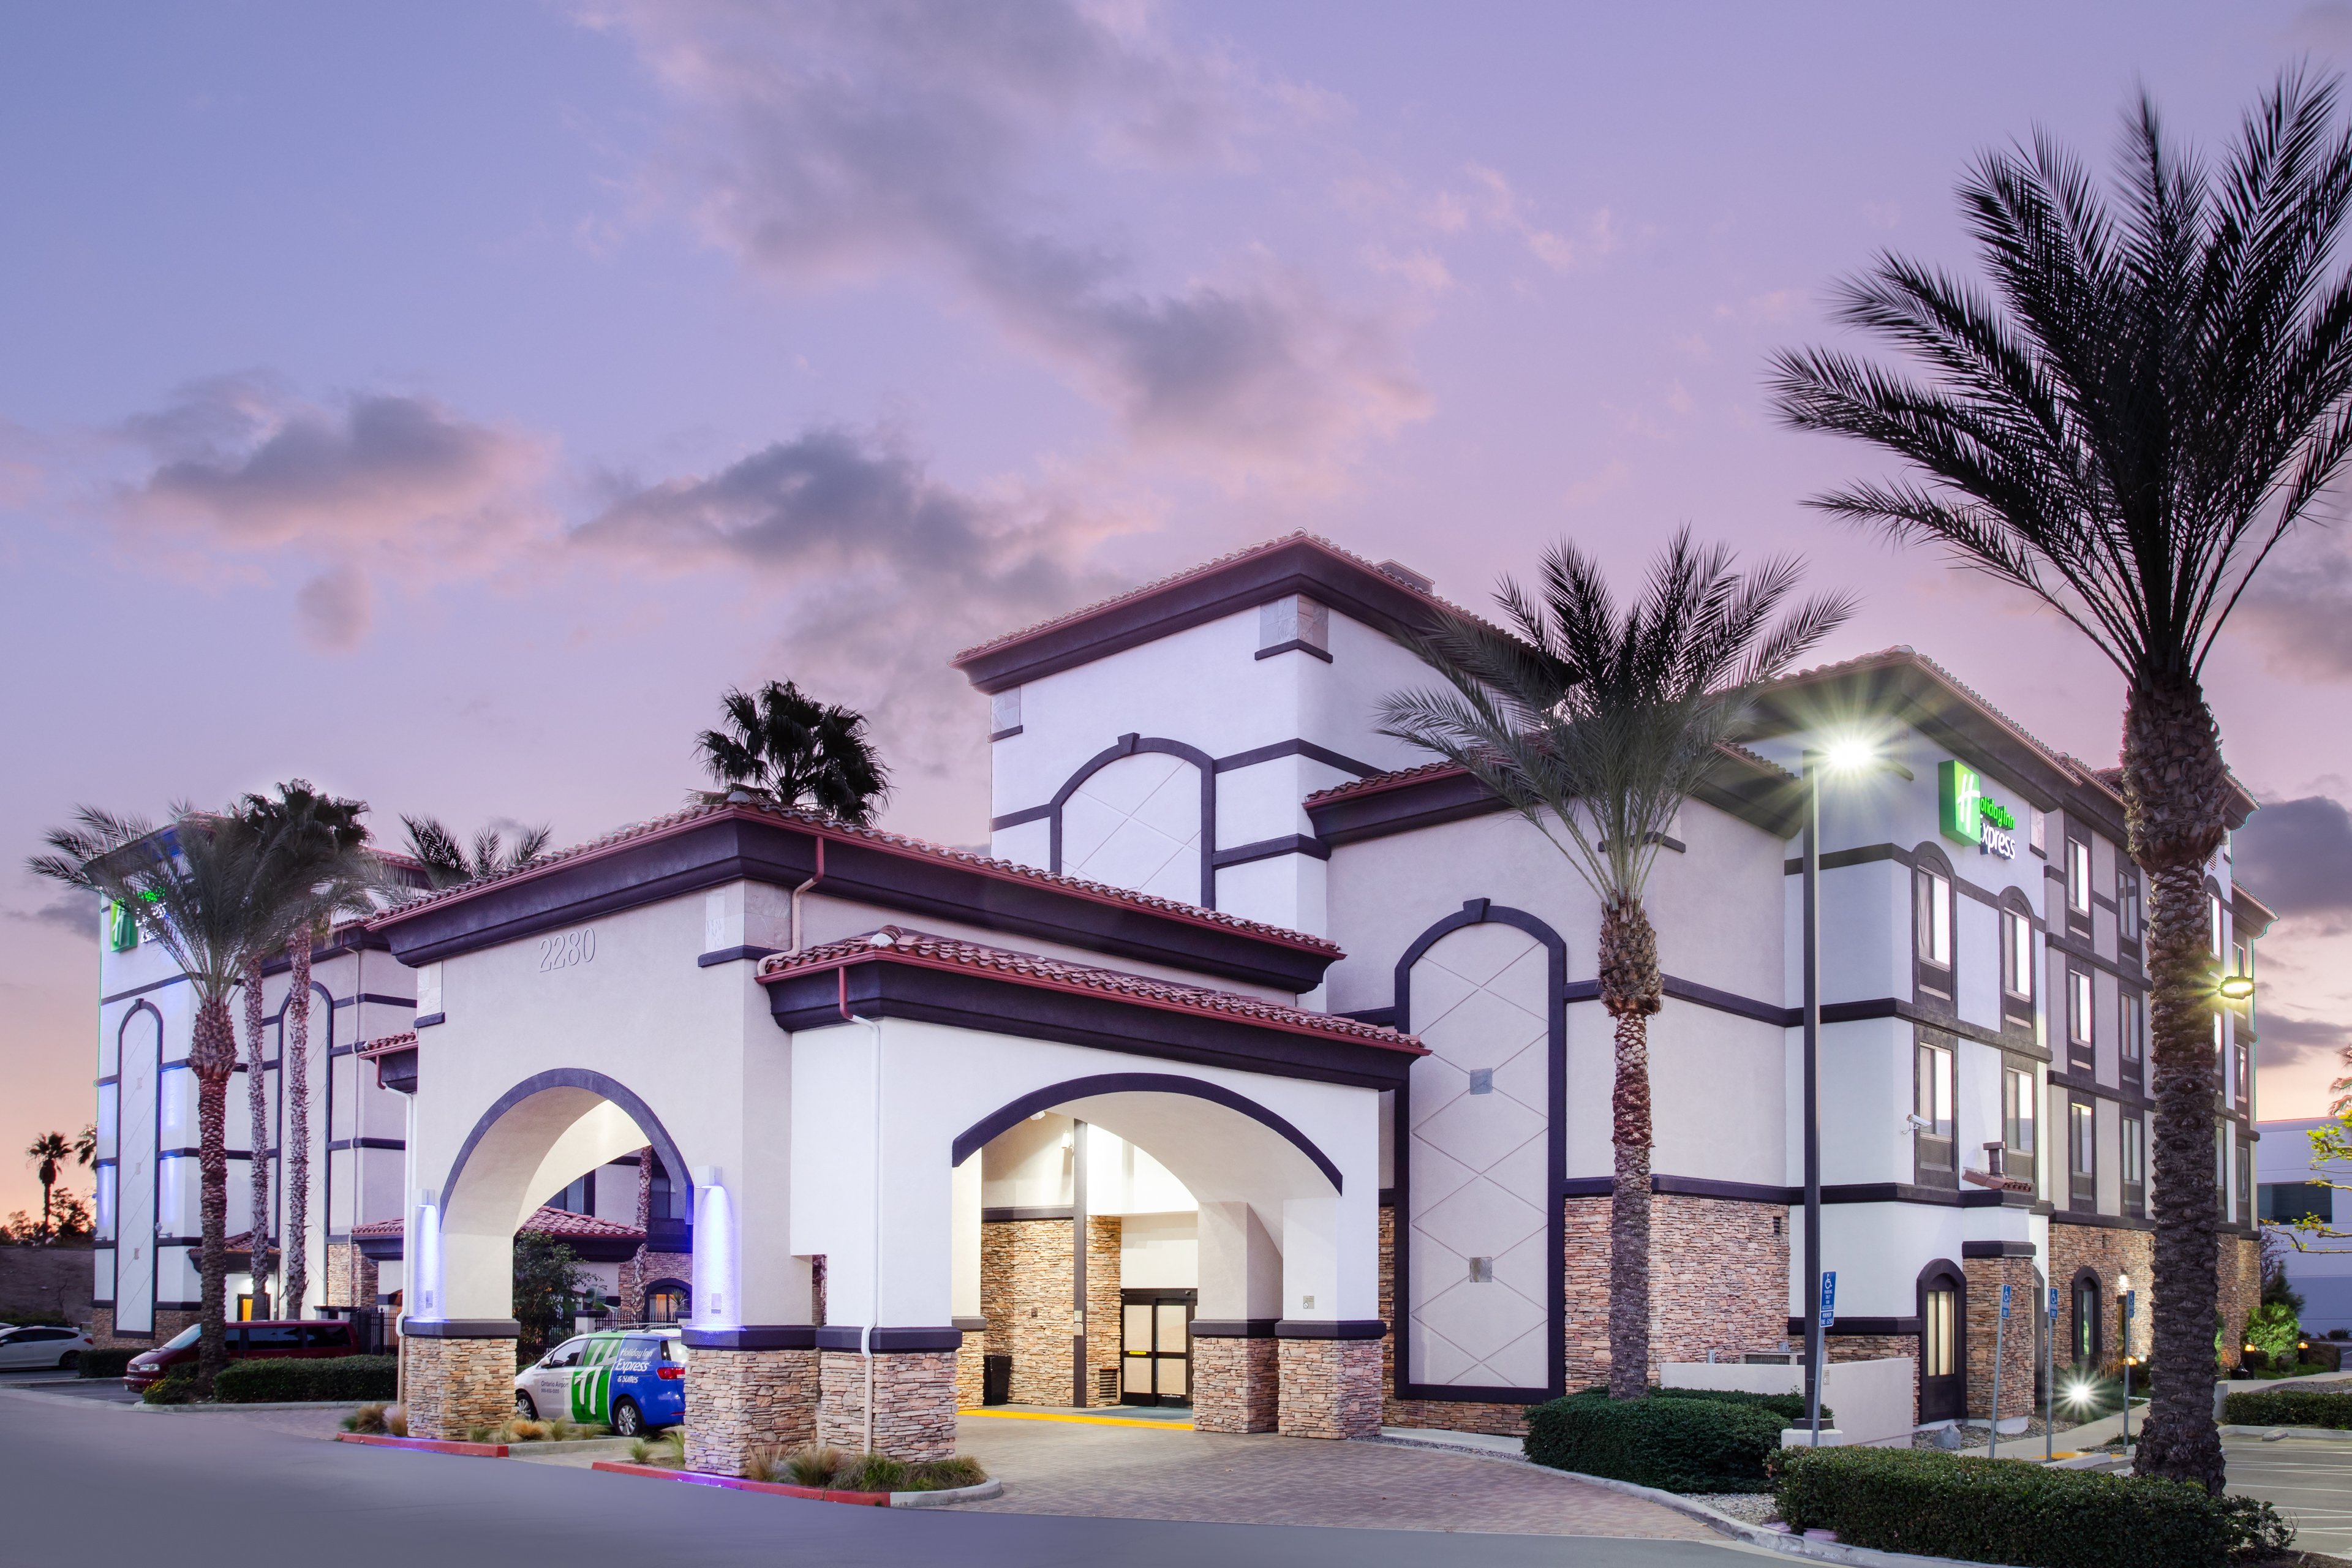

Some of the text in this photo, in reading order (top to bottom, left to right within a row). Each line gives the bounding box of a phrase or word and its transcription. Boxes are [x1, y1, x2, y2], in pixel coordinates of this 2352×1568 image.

[1980, 796, 2003, 827] oliday
[1980, 813, 2016, 859] xpress
[539, 926, 595, 973] 2280
[620, 1348, 654, 1359] Holiday Inn
[615, 1358, 649, 1374] Express
[621, 1375, 639, 1384] Suites
